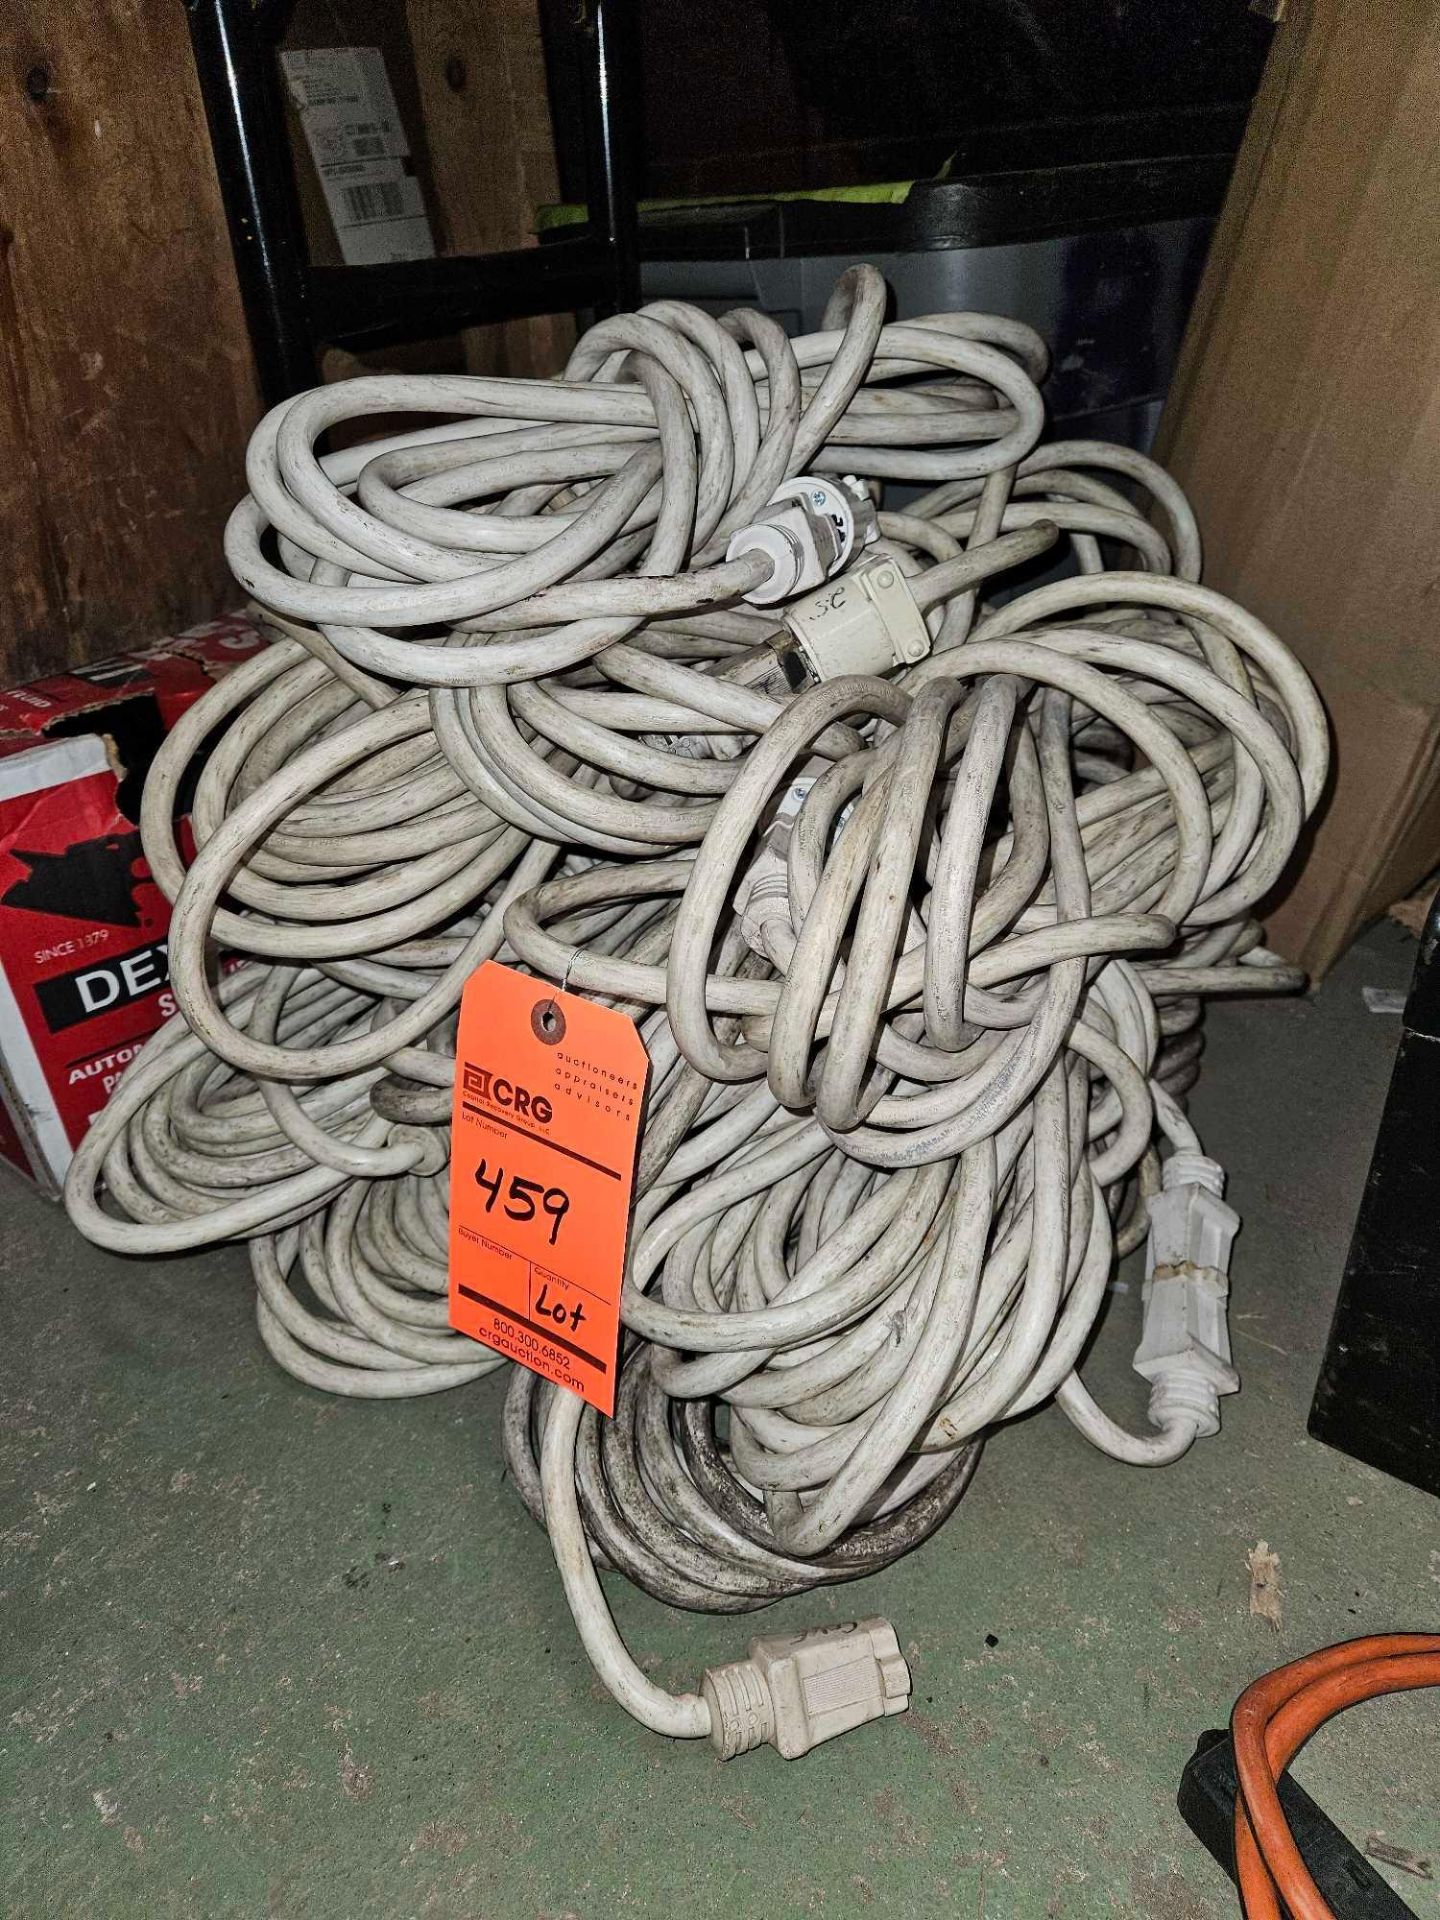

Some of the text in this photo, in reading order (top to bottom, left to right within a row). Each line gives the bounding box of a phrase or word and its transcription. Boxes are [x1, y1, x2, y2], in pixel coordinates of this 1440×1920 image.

[34, 940, 75, 964] SINCE
[555, 1068, 634, 1106] appraisers
[557, 1053, 638, 1091] auctioneers
[493, 1078, 553, 1124] CRG
[554, 1083, 630, 1121] advisors
[462, 1112, 508, 1139] Lot Number
[475, 1158, 570, 1246] 459
[459, 1228, 512, 1260] Buyer Number
[534, 1267, 569, 1291] Quantity
[534, 1284, 587, 1332] Lot
[478, 1326, 585, 1393] crgauction.com
[493, 1318, 571, 1370] 800.300.6852
